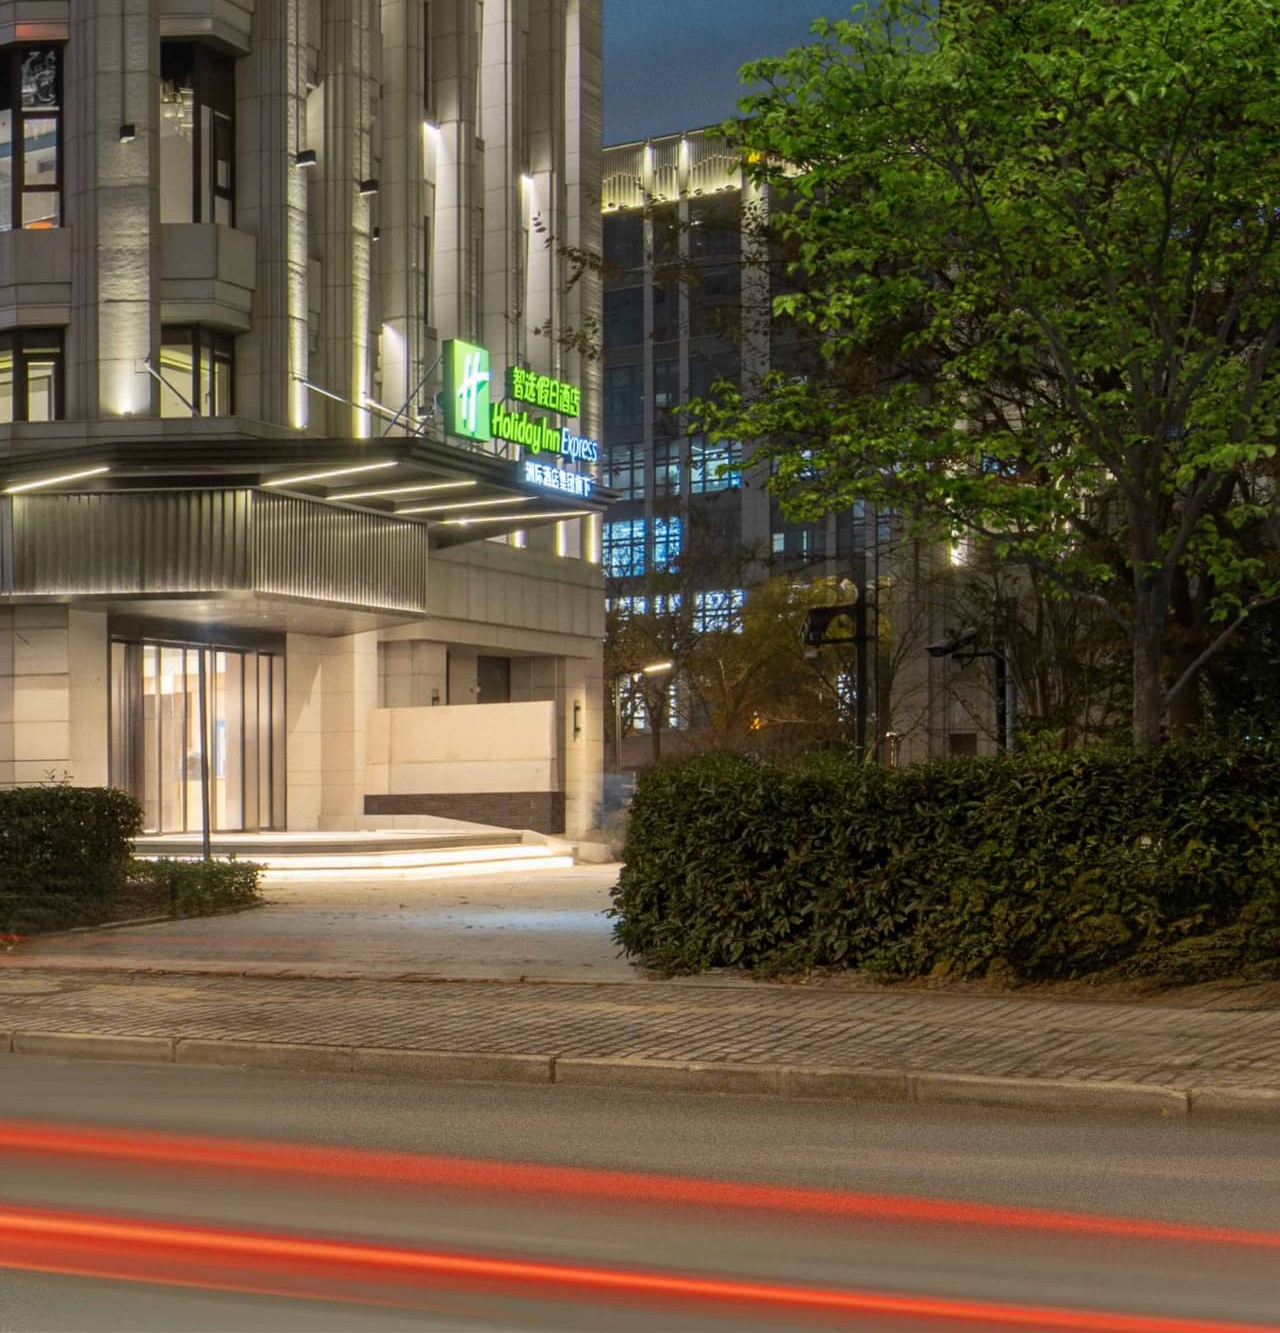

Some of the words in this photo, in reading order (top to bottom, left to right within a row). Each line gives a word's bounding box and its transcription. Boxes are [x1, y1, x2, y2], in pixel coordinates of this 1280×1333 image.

[512, 366, 581, 415] 智选假日酒店
[492, 403, 540, 455] Holiday
[542, 417, 561, 453] Inn
[561, 427, 598, 464] Express
